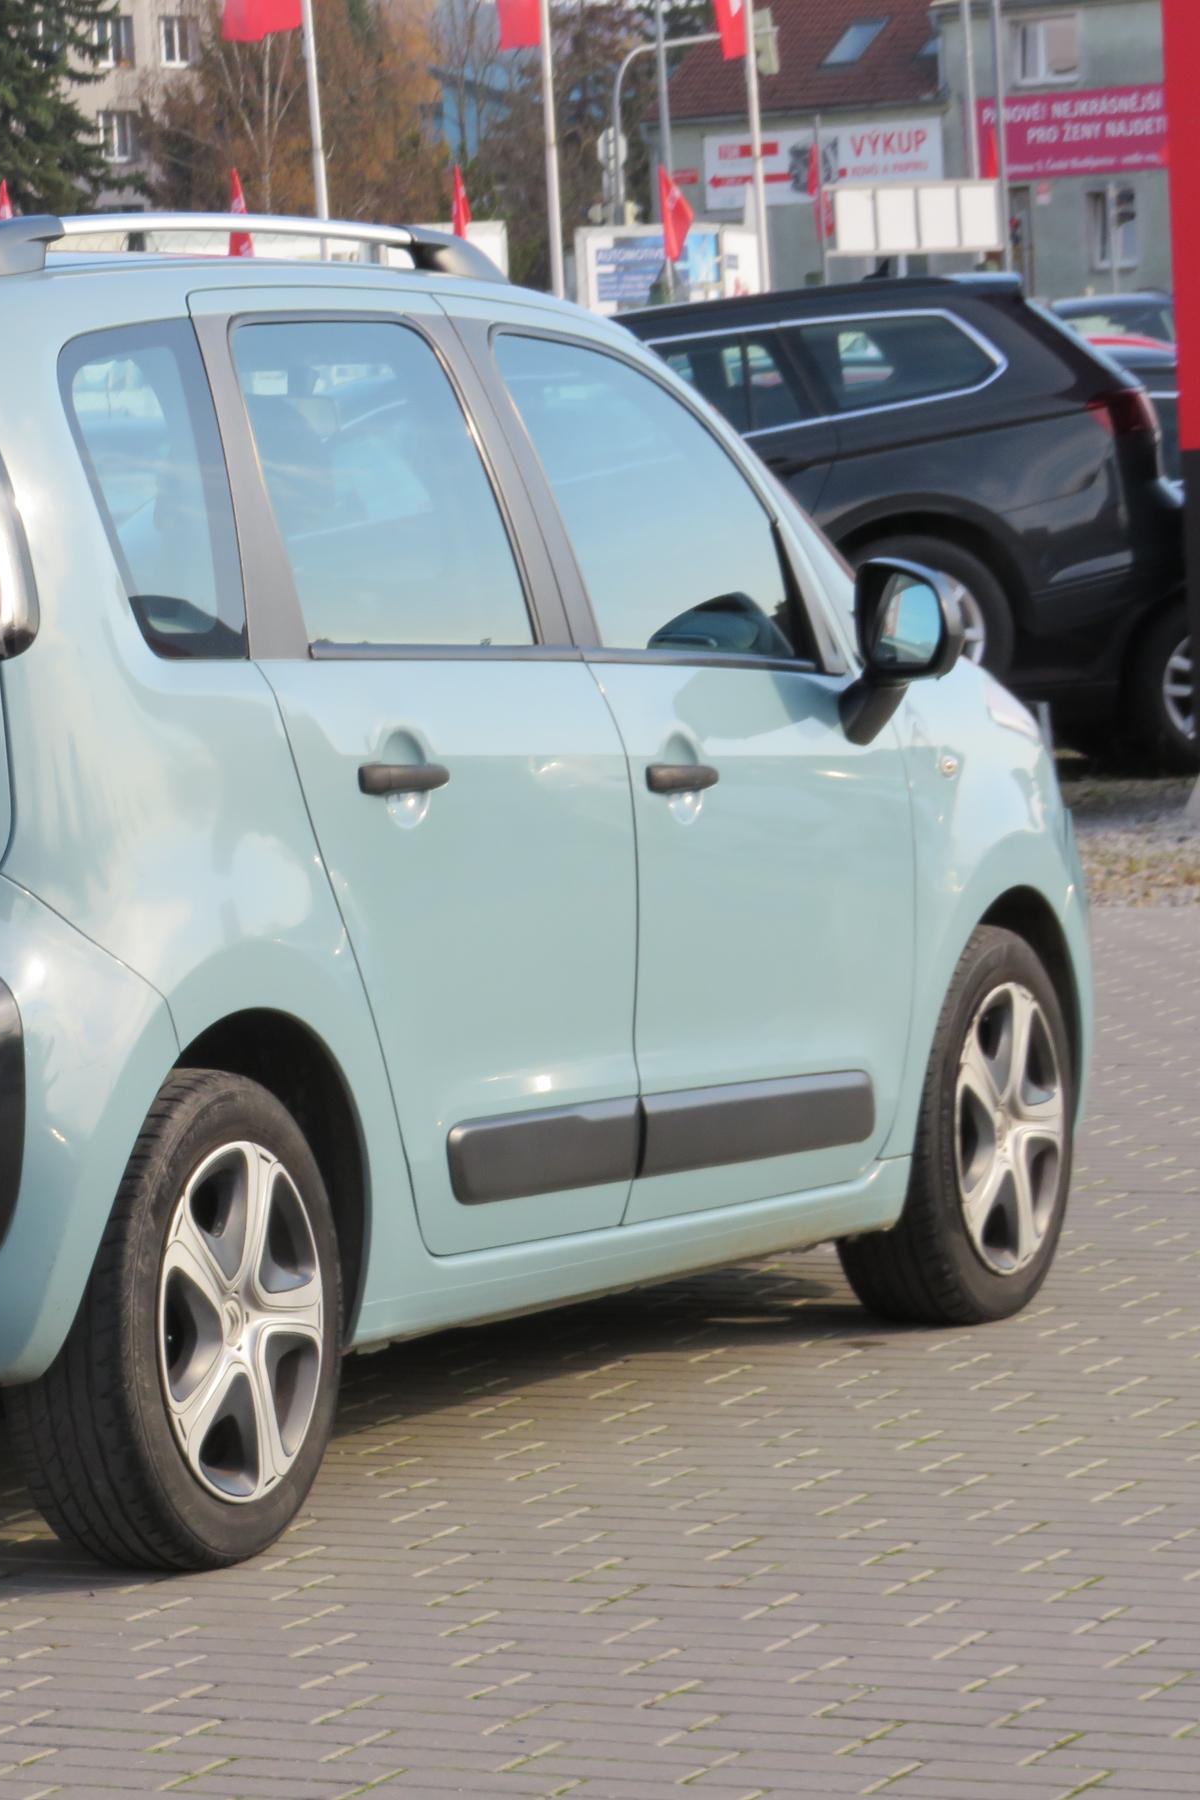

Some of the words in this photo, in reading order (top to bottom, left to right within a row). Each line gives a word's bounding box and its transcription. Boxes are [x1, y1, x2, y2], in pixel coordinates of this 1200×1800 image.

[850, 127, 928, 157] VÝKUP
[1026, 124, 1060, 145] PRO
[1063, 119, 1101, 143] ŽENY
